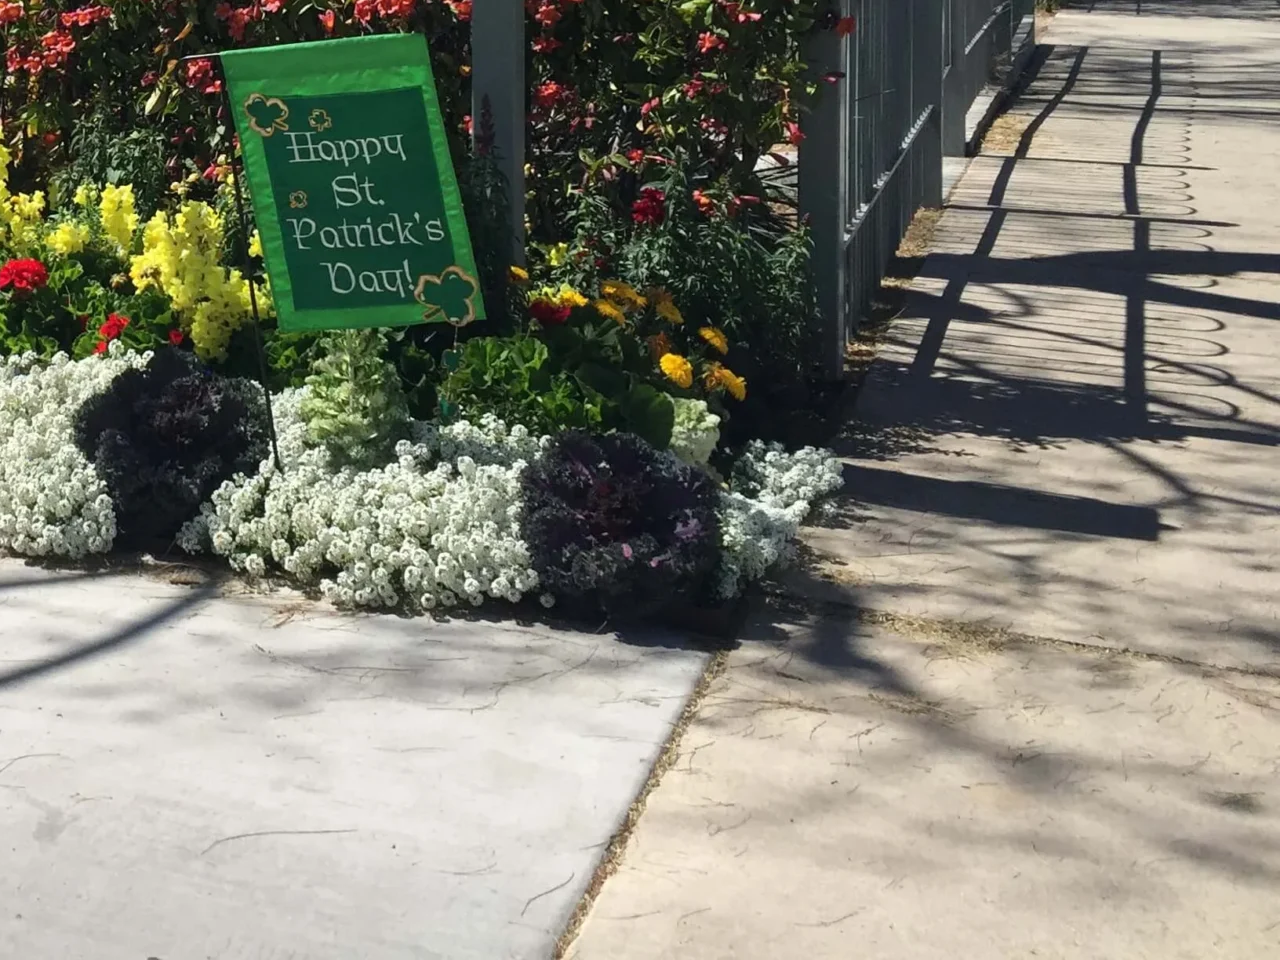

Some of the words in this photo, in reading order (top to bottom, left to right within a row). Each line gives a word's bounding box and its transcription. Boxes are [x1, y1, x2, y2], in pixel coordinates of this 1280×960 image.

[283, 131, 407, 167] Happy
[331, 172, 385, 209] St.
[286, 211, 445, 250] Patrick's
[320, 259, 415, 298] Day!
